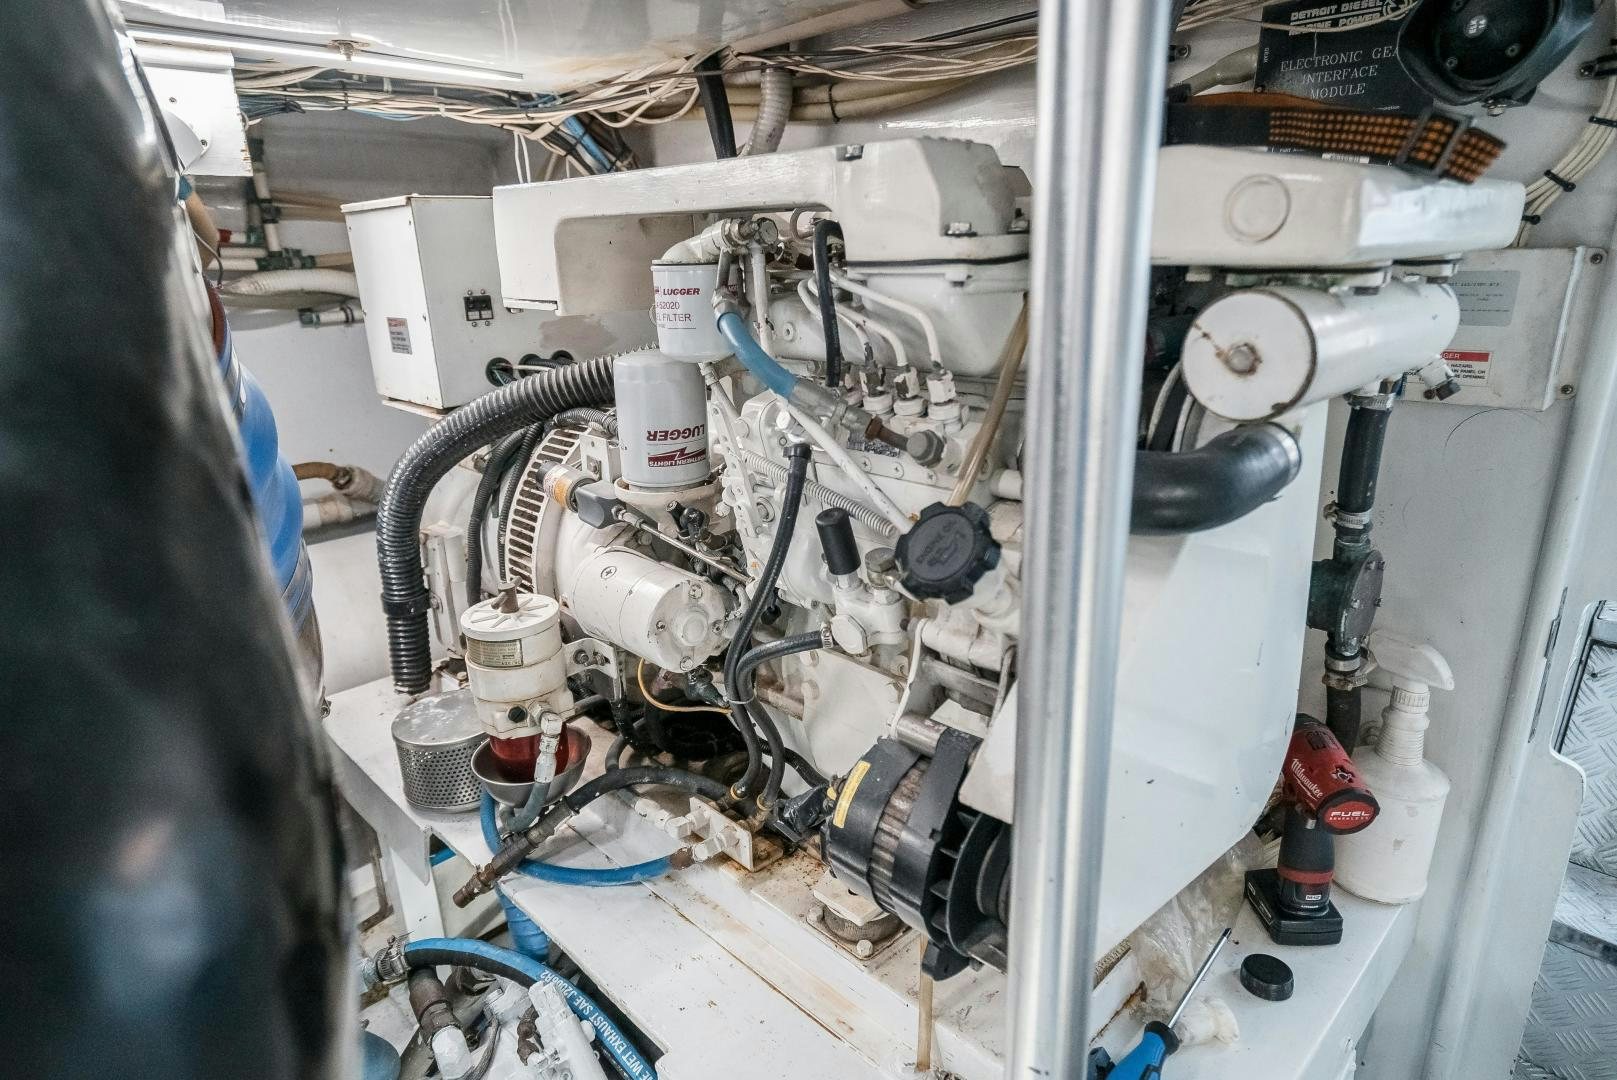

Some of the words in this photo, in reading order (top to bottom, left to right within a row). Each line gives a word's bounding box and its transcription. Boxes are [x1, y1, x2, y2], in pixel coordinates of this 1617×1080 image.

[1290, 5, 1338, 21] DETROIT
[1340, 0, 1383, 12] DIESEL
[1338, 13, 1381, 27] POWER
[1280, 50, 1363, 72] ELECTRONIC
[1371, 45, 1399, 60] GEA
[1302, 64, 1379, 85] INTERFACE
[1310, 82, 1367, 100] MODULE
[663, 287, 700, 296] LUGGER
[662, 313, 692, 322] FILTER
[1440, 352, 1460, 360] GER
[646, 424, 705, 442] LUGGER
[649, 460, 676, 468] LIGHTS
[1291, 758, 1324, 799] Milwaukee
[1330, 810, 1371, 818] FUEL
[573, 995, 593, 1016] SAE
[588, 1012, 628, 1055] EXHAUST
[621, 1051, 644, 1076] WET
